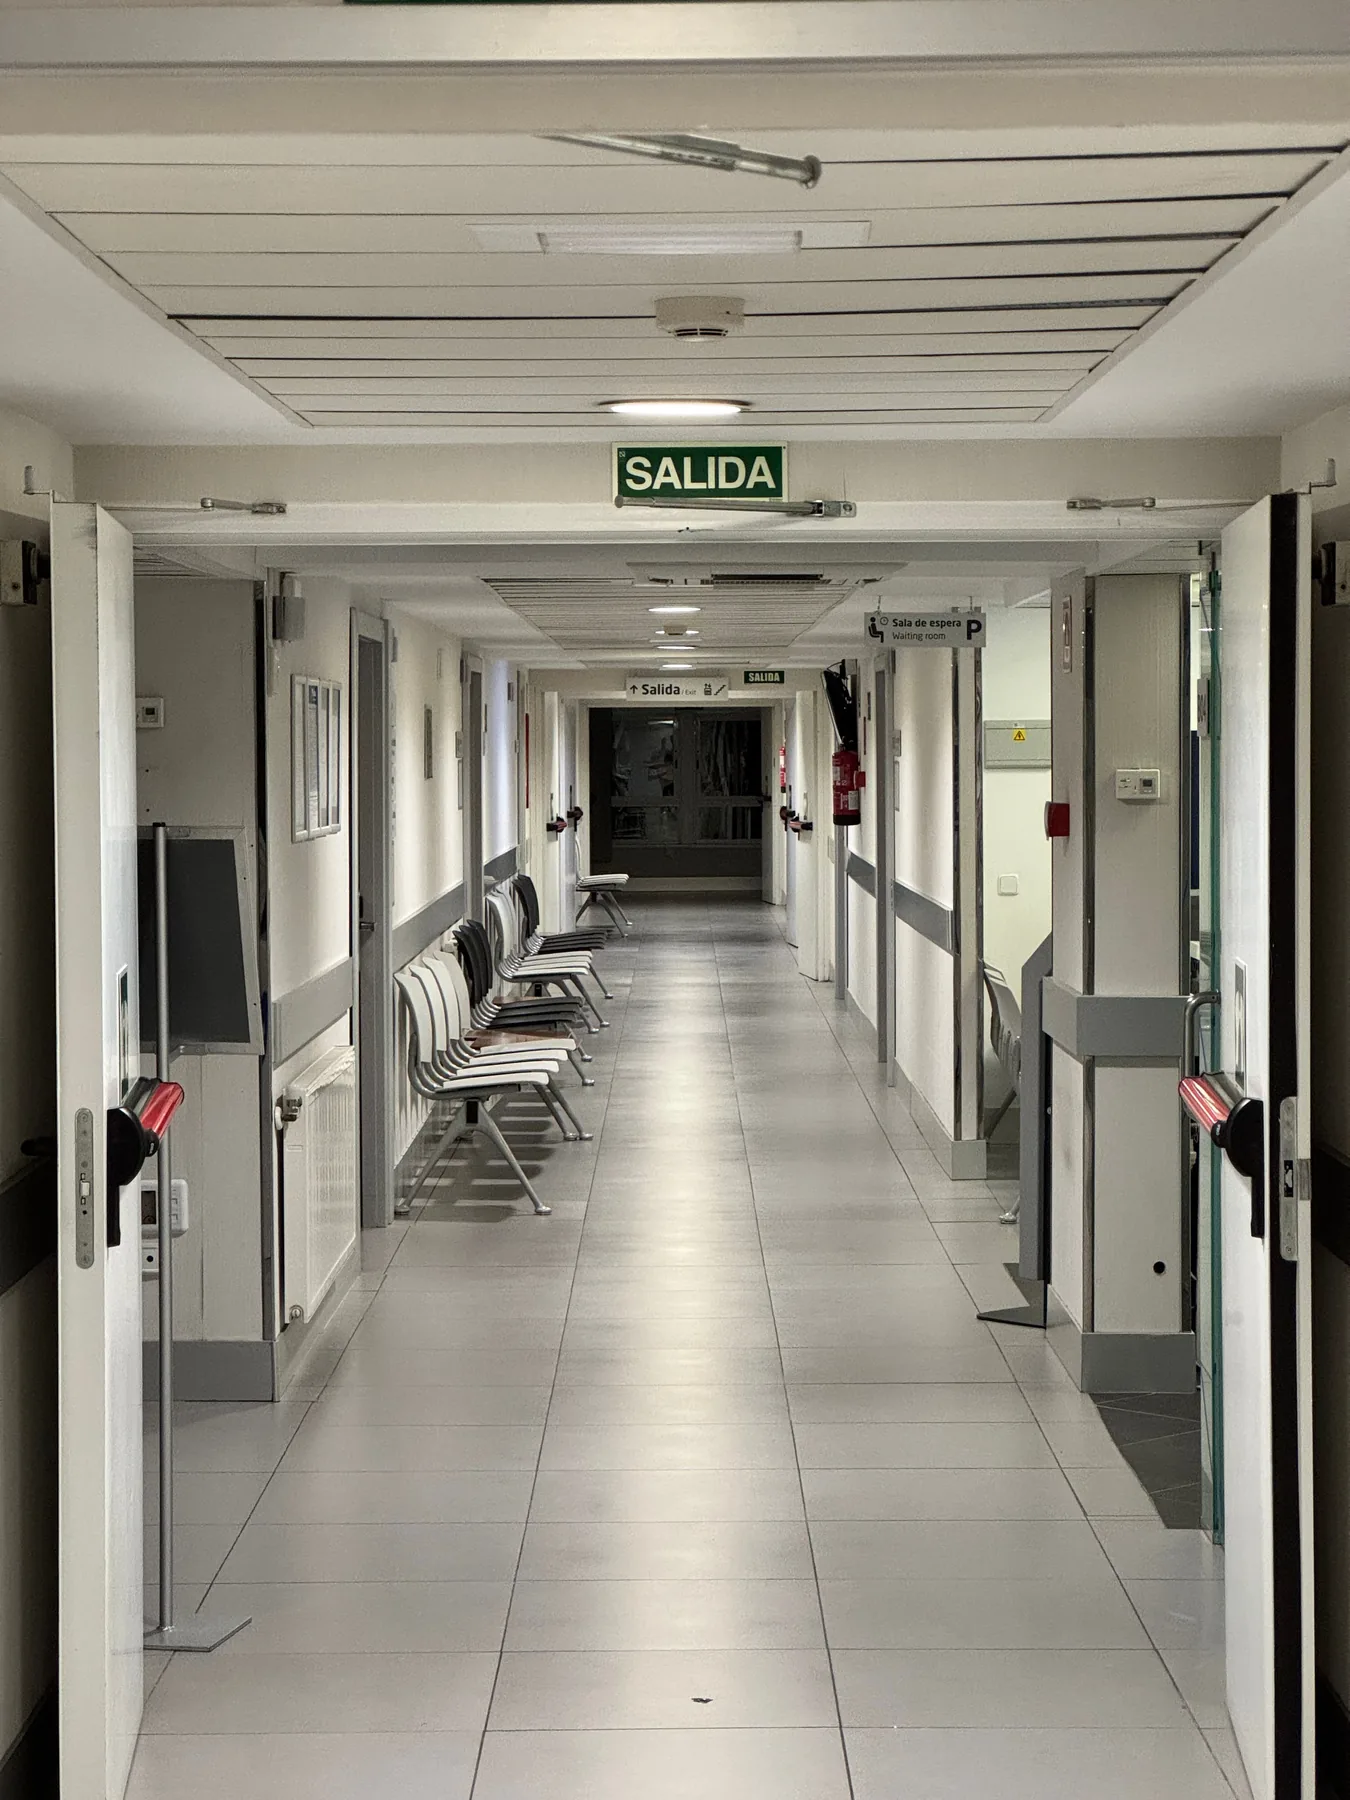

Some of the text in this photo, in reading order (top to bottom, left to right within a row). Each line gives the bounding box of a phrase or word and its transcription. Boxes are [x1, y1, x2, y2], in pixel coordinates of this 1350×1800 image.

[625, 456, 776, 491] SALIDA
[892, 618, 962, 629] Sala de espera
[966, 619, 982, 640] P
[892, 631, 946, 642] Waiting room
[748, 672, 780, 682] SALIDA
[641, 683, 681, 696] Salida
